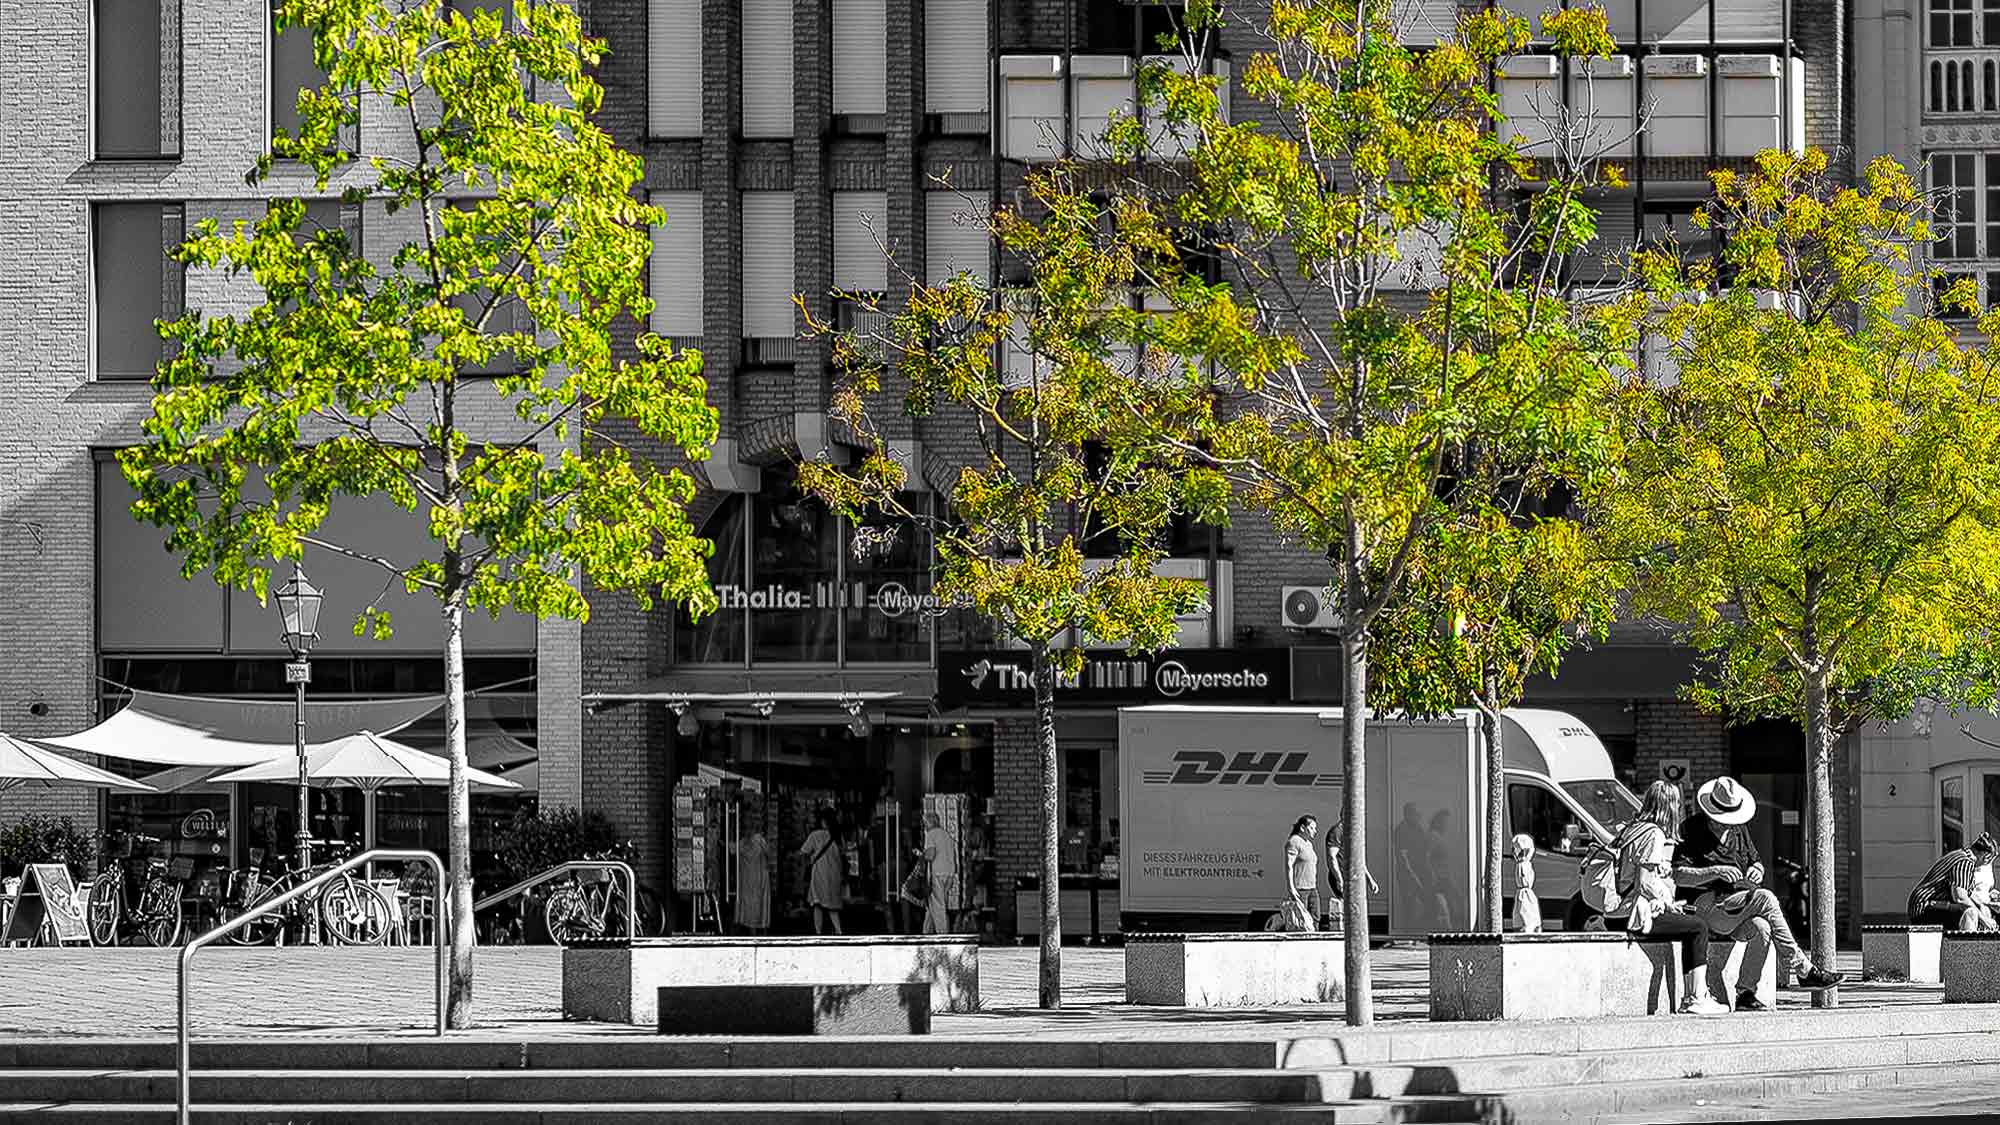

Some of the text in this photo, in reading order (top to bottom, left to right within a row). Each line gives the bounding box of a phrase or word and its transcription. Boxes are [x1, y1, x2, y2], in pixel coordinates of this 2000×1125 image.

[715, 584, 801, 608] Thalia
[993, 664, 1268, 691] Thlia Mayersche
[1559, 727, 1591, 737] DHL
[1170, 750, 1318, 786] DHL
[1889, 783, 1897, 796] 2
[1143, 852, 1177, 863] DIESES
[1179, 852, 1228, 863] FAHRZEUG
[1143, 867, 1160, 878] MIT
